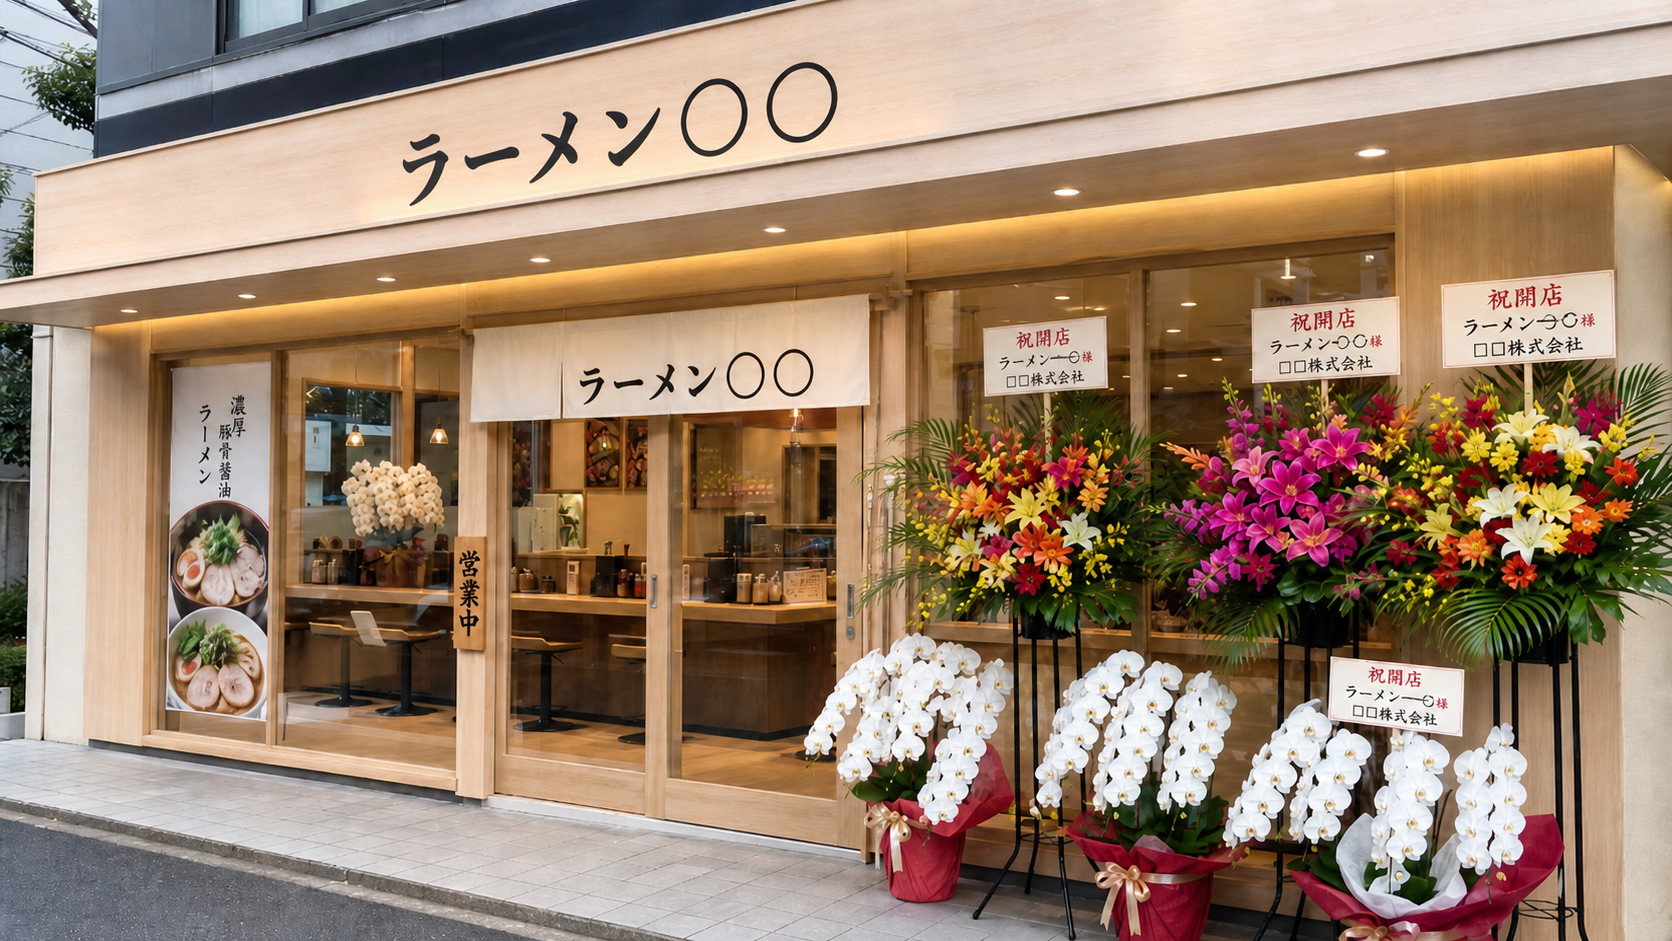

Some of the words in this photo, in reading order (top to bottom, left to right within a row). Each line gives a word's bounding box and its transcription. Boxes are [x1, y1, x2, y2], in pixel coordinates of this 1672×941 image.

[1487, 283, 1563, 310] 祝開店
[1290, 308, 1356, 332] 祝開店
[1016, 327, 1070, 349] 祝開店
[231, 395, 247, 437] 濃厚
[199, 404, 211, 484] ラーメン
[219, 424, 232, 498] 豚骨醤油
[459, 550, 480, 637] 営業中
[1368, 666, 1422, 688] 祝開店
